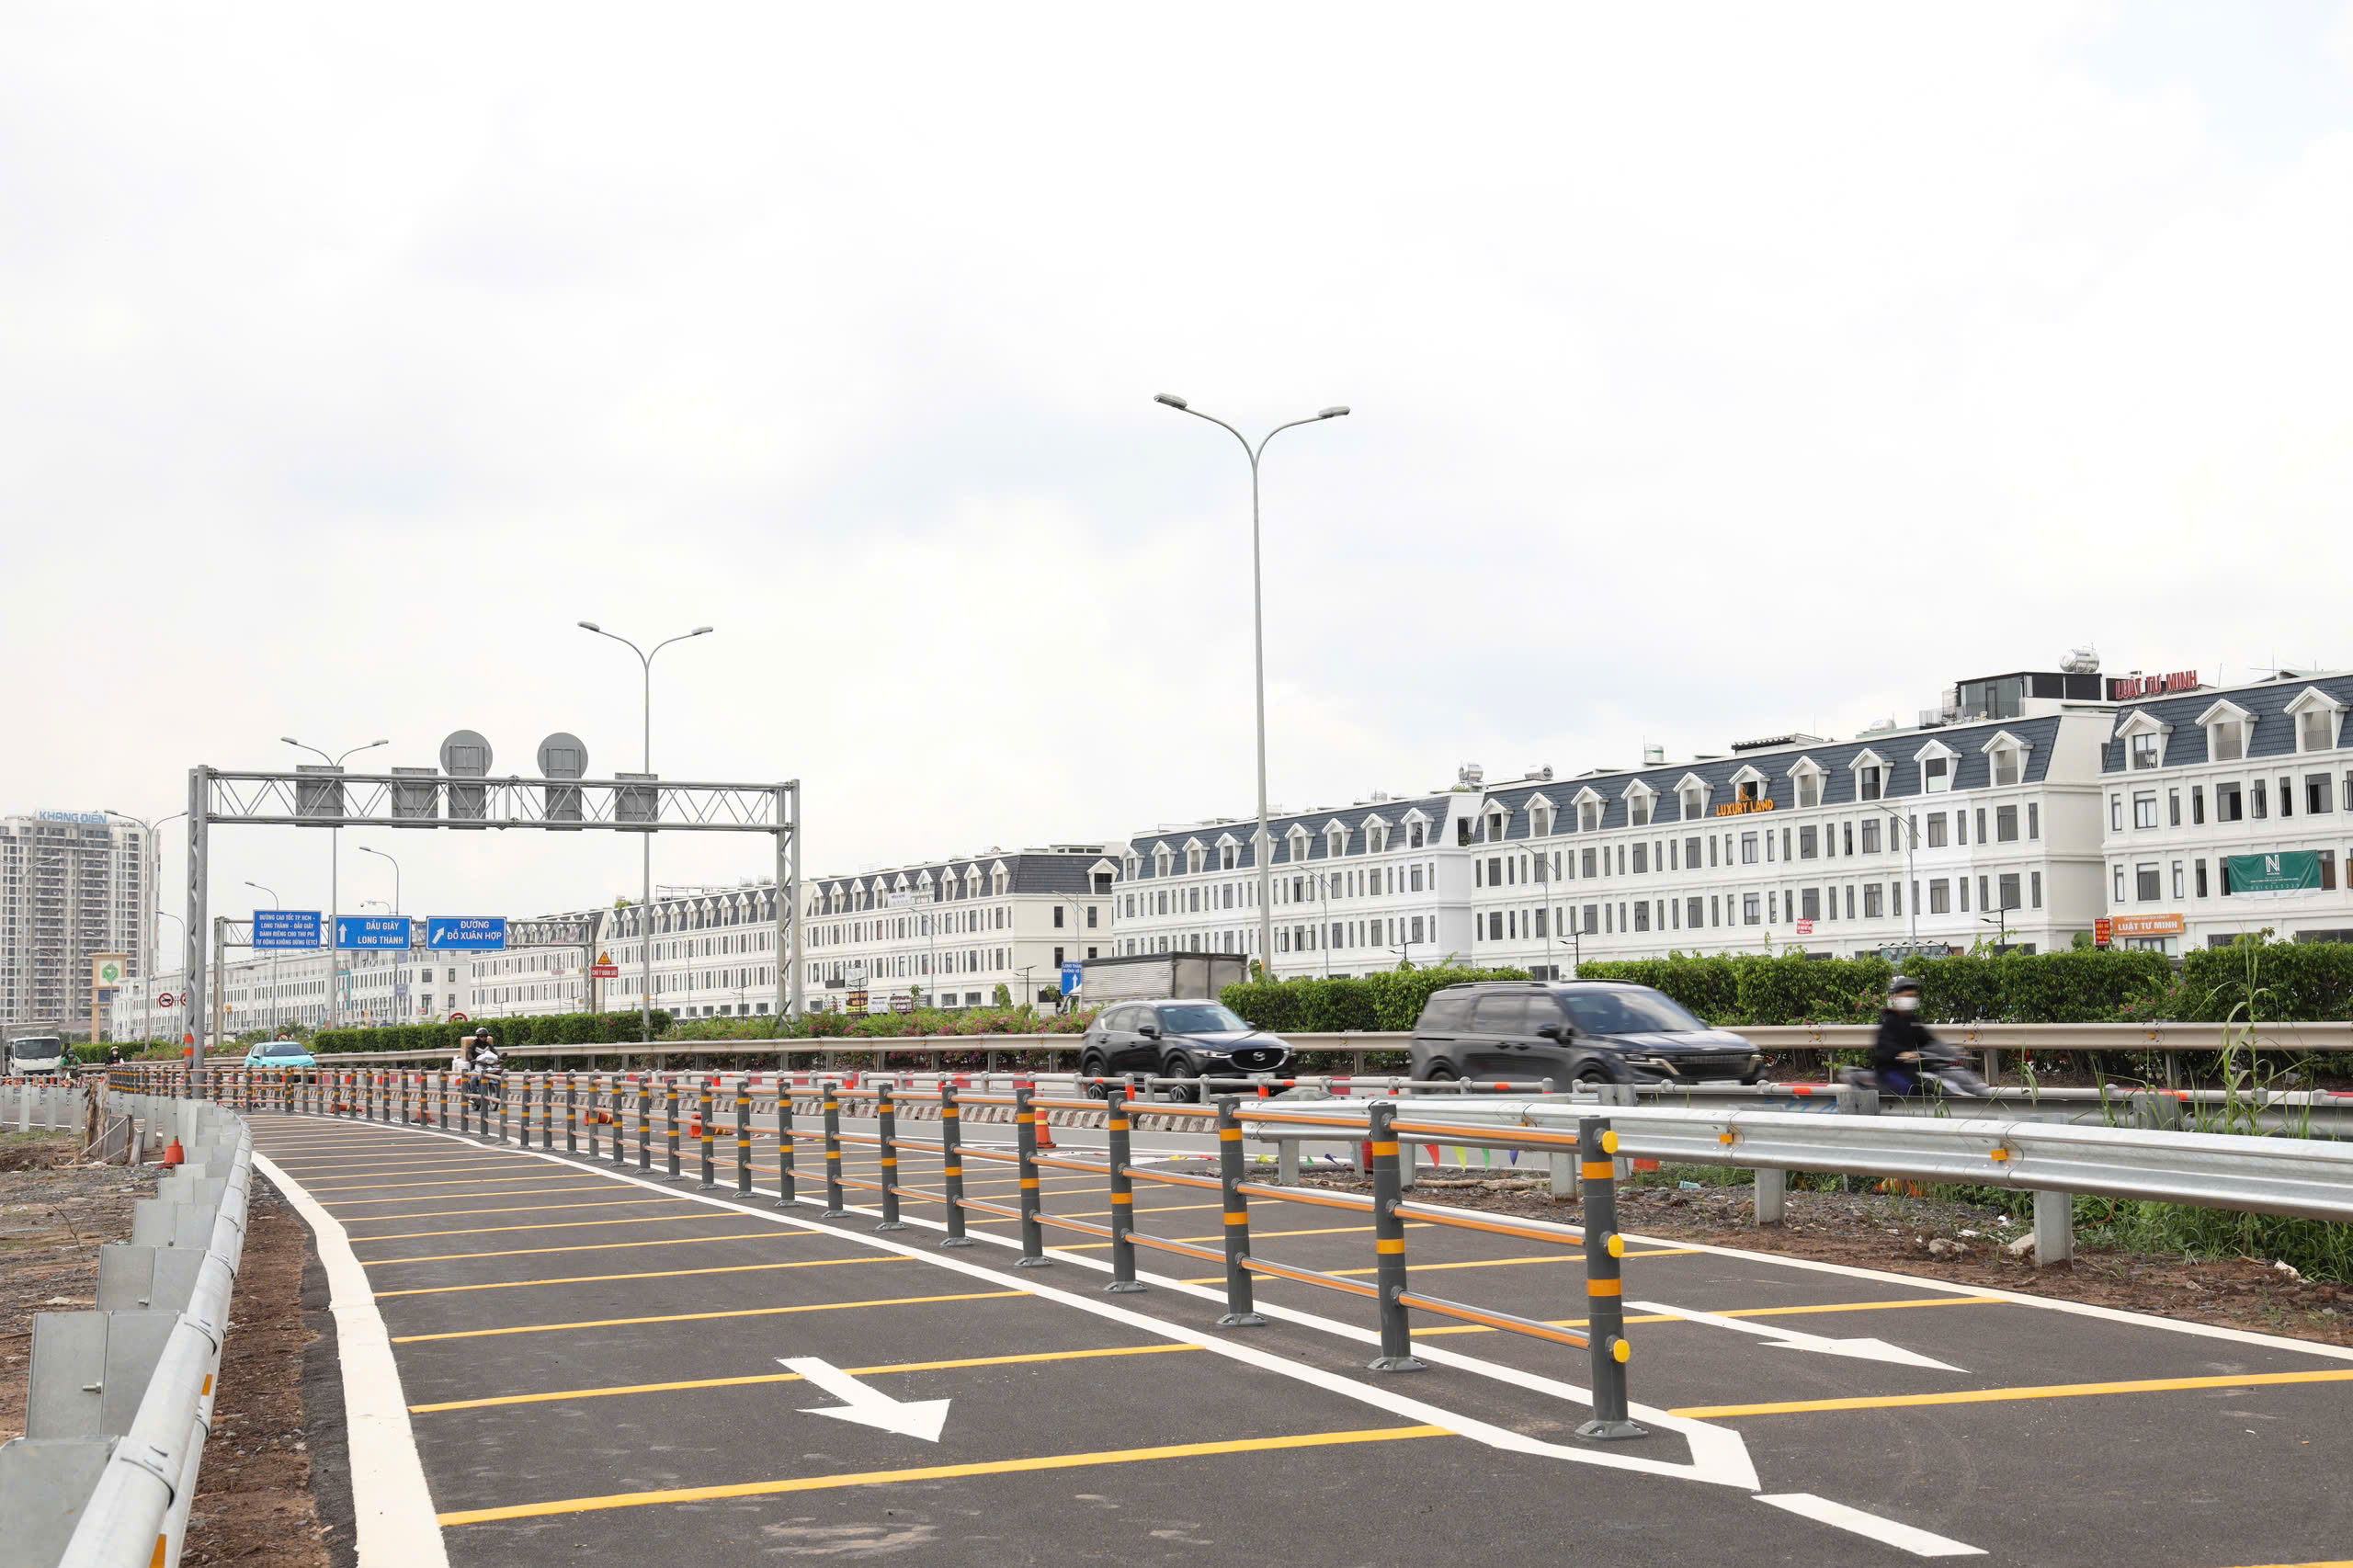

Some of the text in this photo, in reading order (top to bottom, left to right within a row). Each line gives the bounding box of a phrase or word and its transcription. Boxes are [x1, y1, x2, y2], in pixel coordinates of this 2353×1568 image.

[2115, 669, 2198, 700] LUẬT TƯ MINH
[1715, 799, 1774, 816] LUXURY LAND
[40, 810, 79, 823] KHANG
[382, 921, 399, 930] GIÂY
[460, 919, 490, 929] ĐƯỜNG
[2118, 921, 2177, 932] LUẬT TƯ MINH
[358, 934, 404, 944] LONG THÀNH
[460, 930, 483, 939] XUÂN
[484, 931, 502, 941] HỢP
